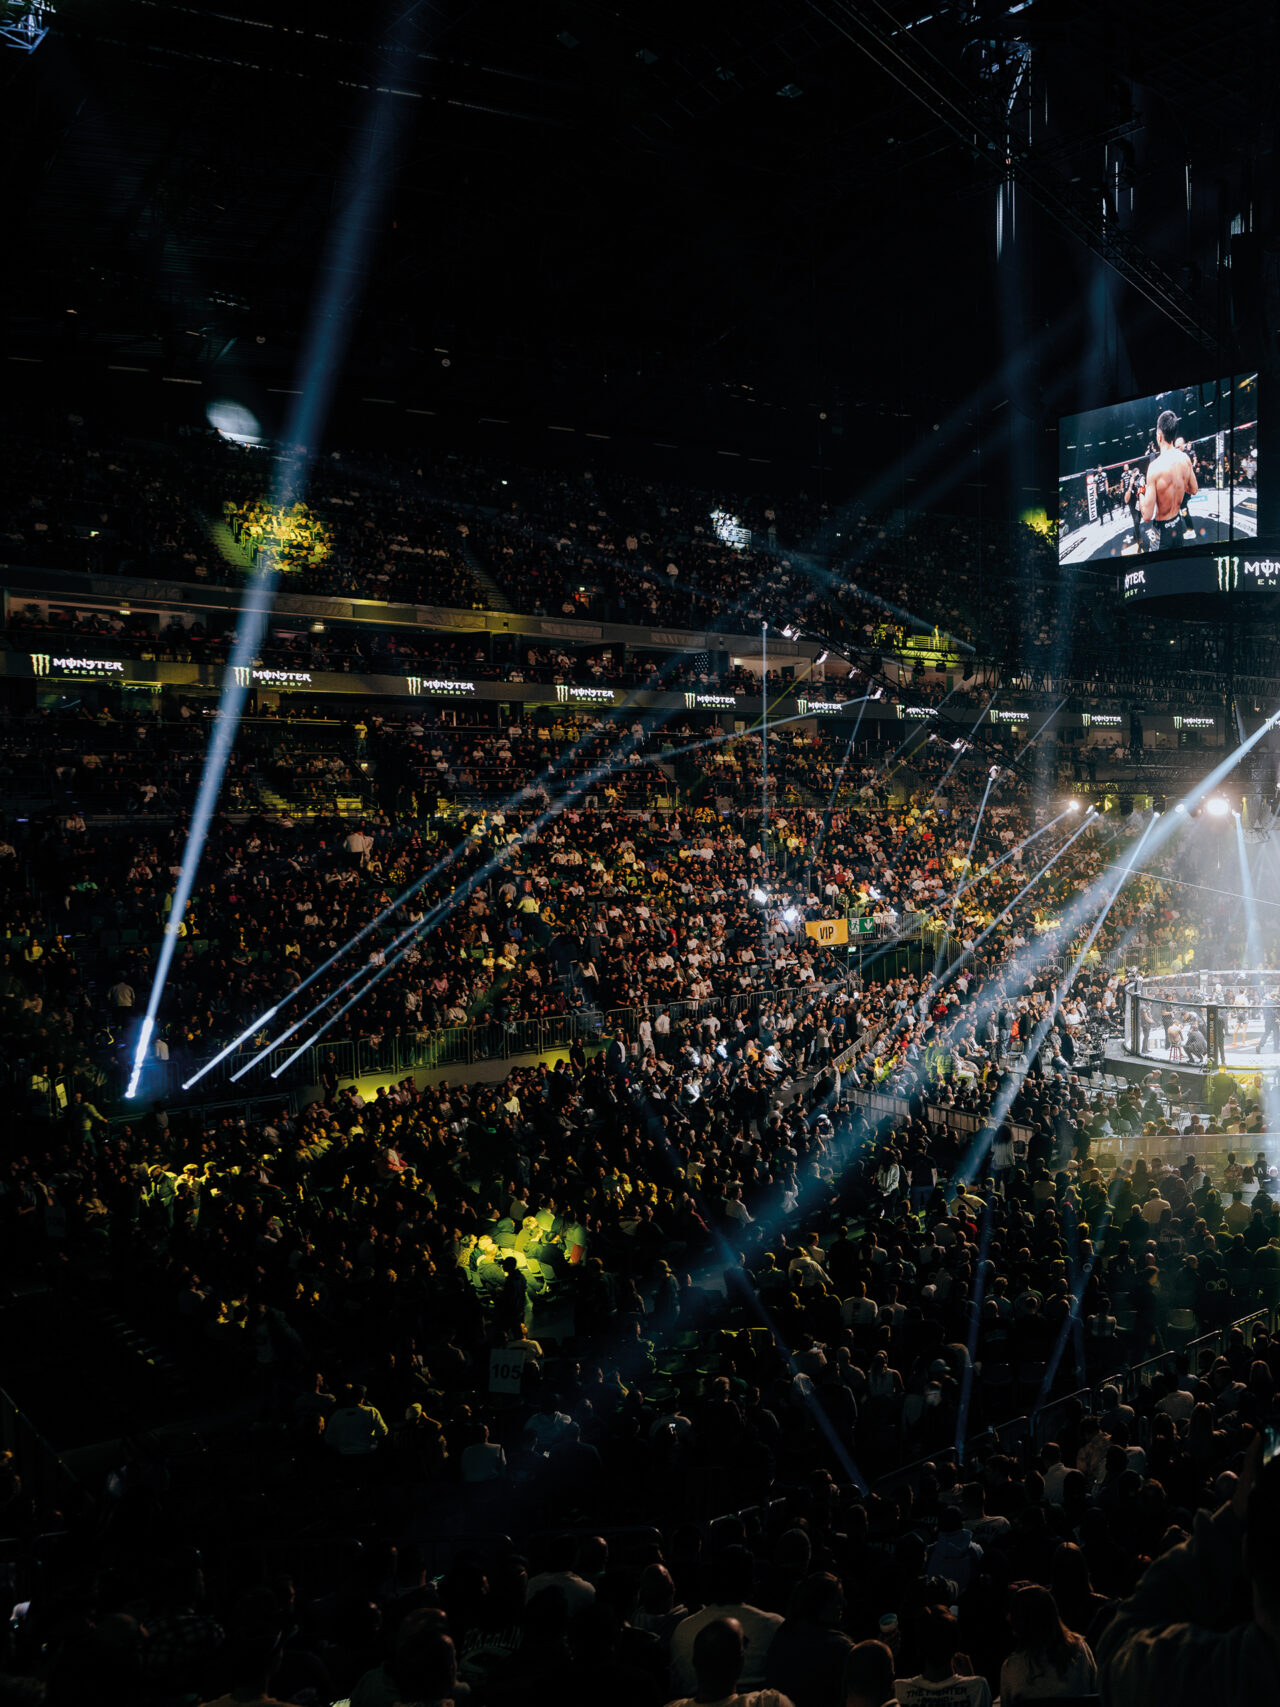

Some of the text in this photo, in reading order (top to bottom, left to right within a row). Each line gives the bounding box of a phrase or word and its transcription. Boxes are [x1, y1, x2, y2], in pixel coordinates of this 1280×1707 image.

[53, 658, 124, 671] MONSTER
[252, 670, 312, 682] MONSTER
[423, 680, 475, 691] MONSTER
[570, 688, 615, 697] MONSTER
[697, 695, 736, 705] MONSTER
[820, 926, 834, 940] VIP
[492, 1364, 521, 1380] 105
